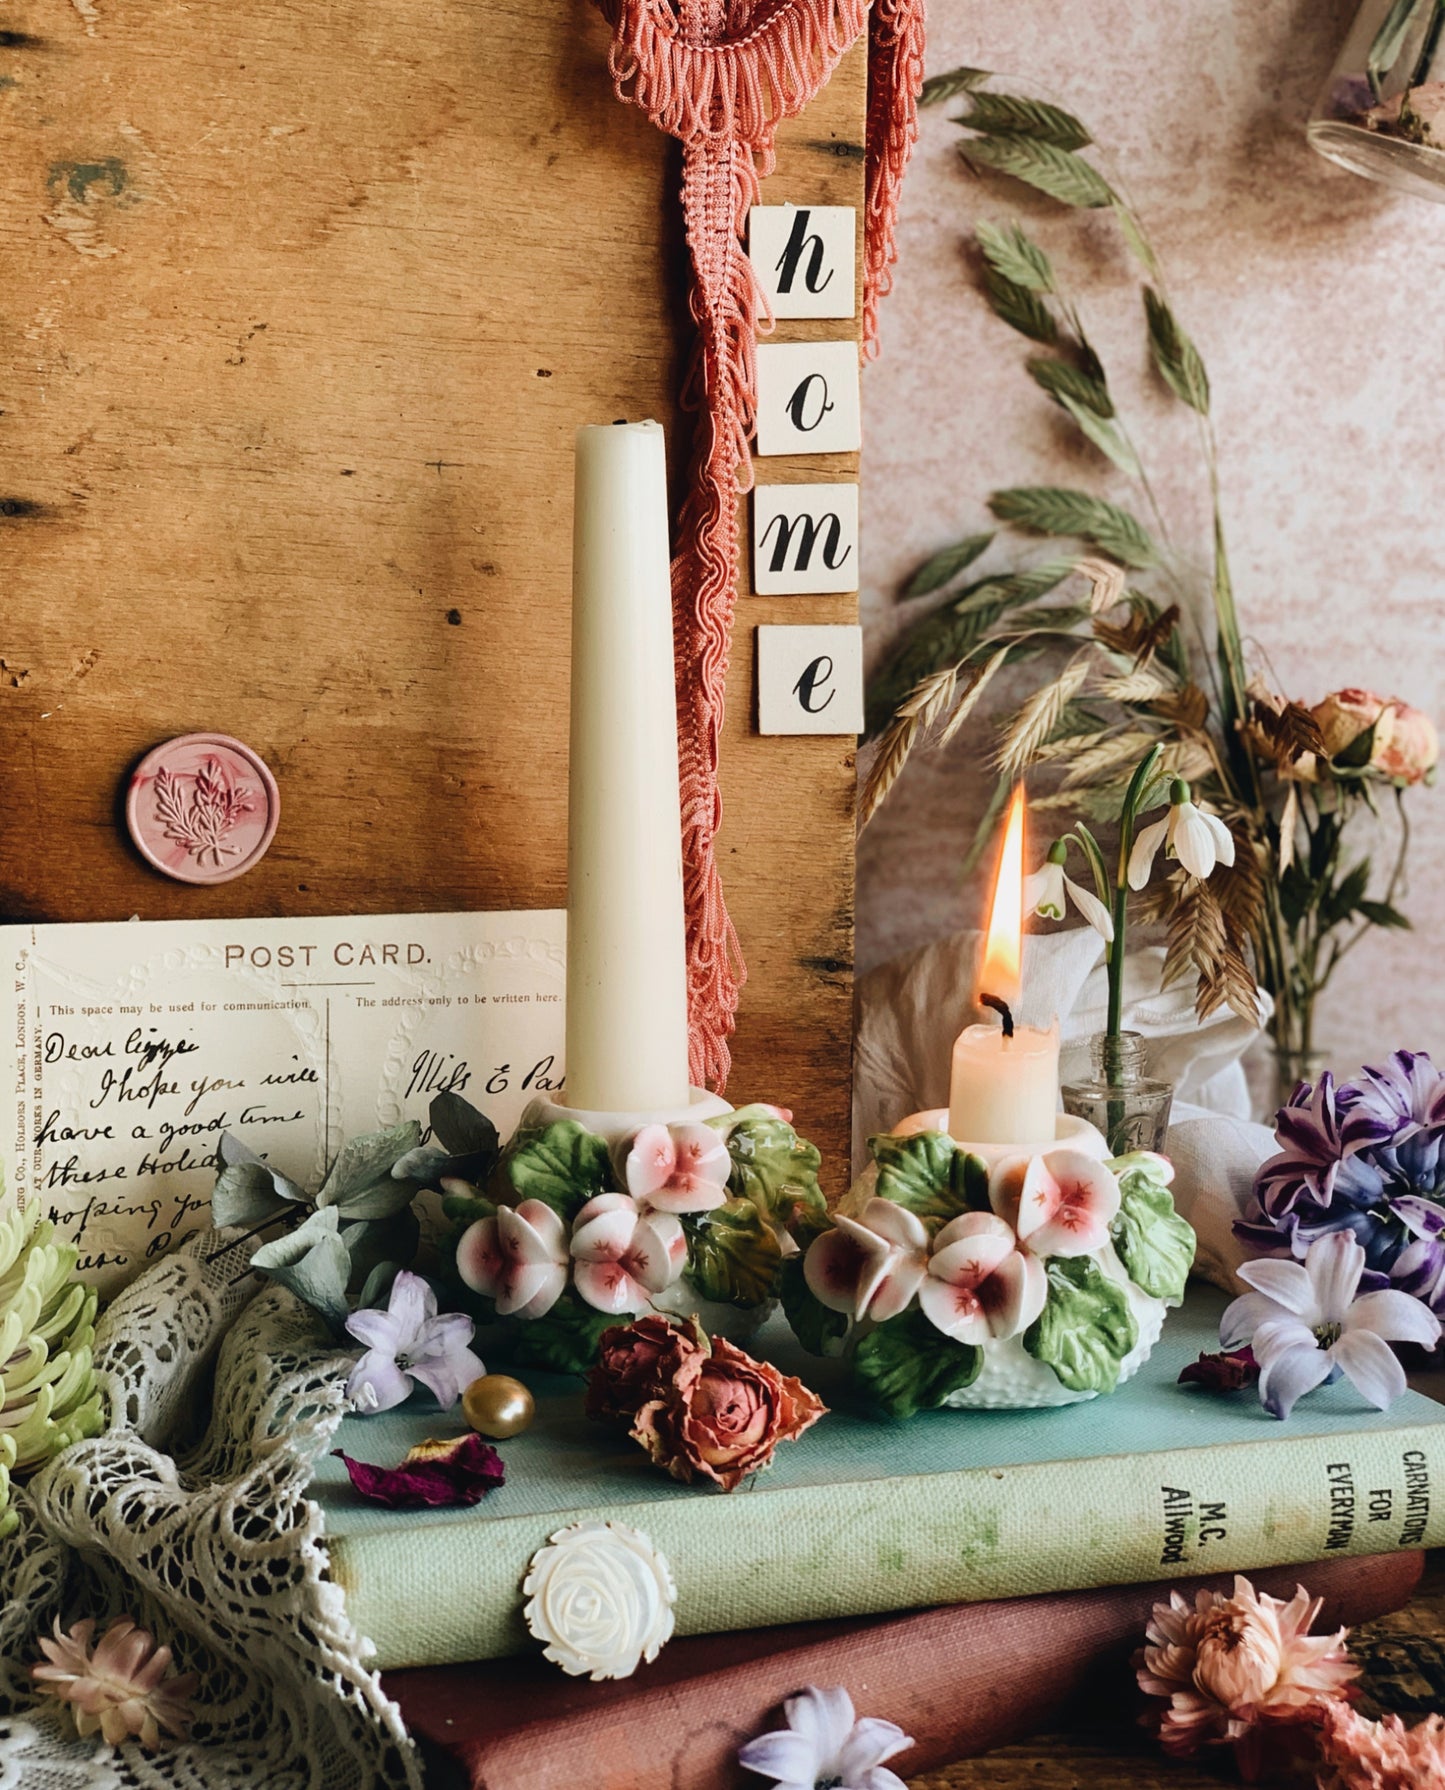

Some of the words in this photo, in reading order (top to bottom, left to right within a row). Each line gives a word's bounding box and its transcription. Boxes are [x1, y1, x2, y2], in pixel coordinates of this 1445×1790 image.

[225, 944, 318, 968] POST
[333, 942, 432, 966] CARD.
[49, 1004, 75, 1016] This
[81, 1003, 113, 1017] space
[120, 1003, 143, 1016] may
[150, 1002, 163, 1013] be
[169, 1001, 195, 1013] used
[201, 1000, 217, 1012] for
[223, 999, 312, 1011] communication.
[356, 996, 376, 1007] The
[382, 996, 423, 1007] address
[429, 995, 452, 1007] only
[457, 996, 469, 1005] to
[474, 994, 487, 1004] be
[492, 994, 530, 1004] written
[536, 992, 563, 1003] here.
[45, 1032, 116, 1063] Dear
[34, 1087, 42, 1099] IN
[118, 1067, 181, 1109] hope
[184, 1076, 246, 1116] you
[260, 1055, 319, 1086] will
[485, 1064, 510, 1094] E
[33, 1110, 115, 1148] have
[131, 1125, 154, 1139] a
[159, 1112, 232, 1150] good
[240, 1105, 305, 1125] time
[34, 1149, 42, 1171] OUR
[46, 1155, 127, 1189] these
[34, 1177, 42, 1191] AT
[16, 1187, 25, 1215] HING
[1324, 1463, 1354, 1550] EVERYMAN
[1368, 1489, 1392, 1523] FOR
[1398, 1450, 1430, 1545] CARNATIONS
[1160, 1486, 1193, 1565] Allwood
